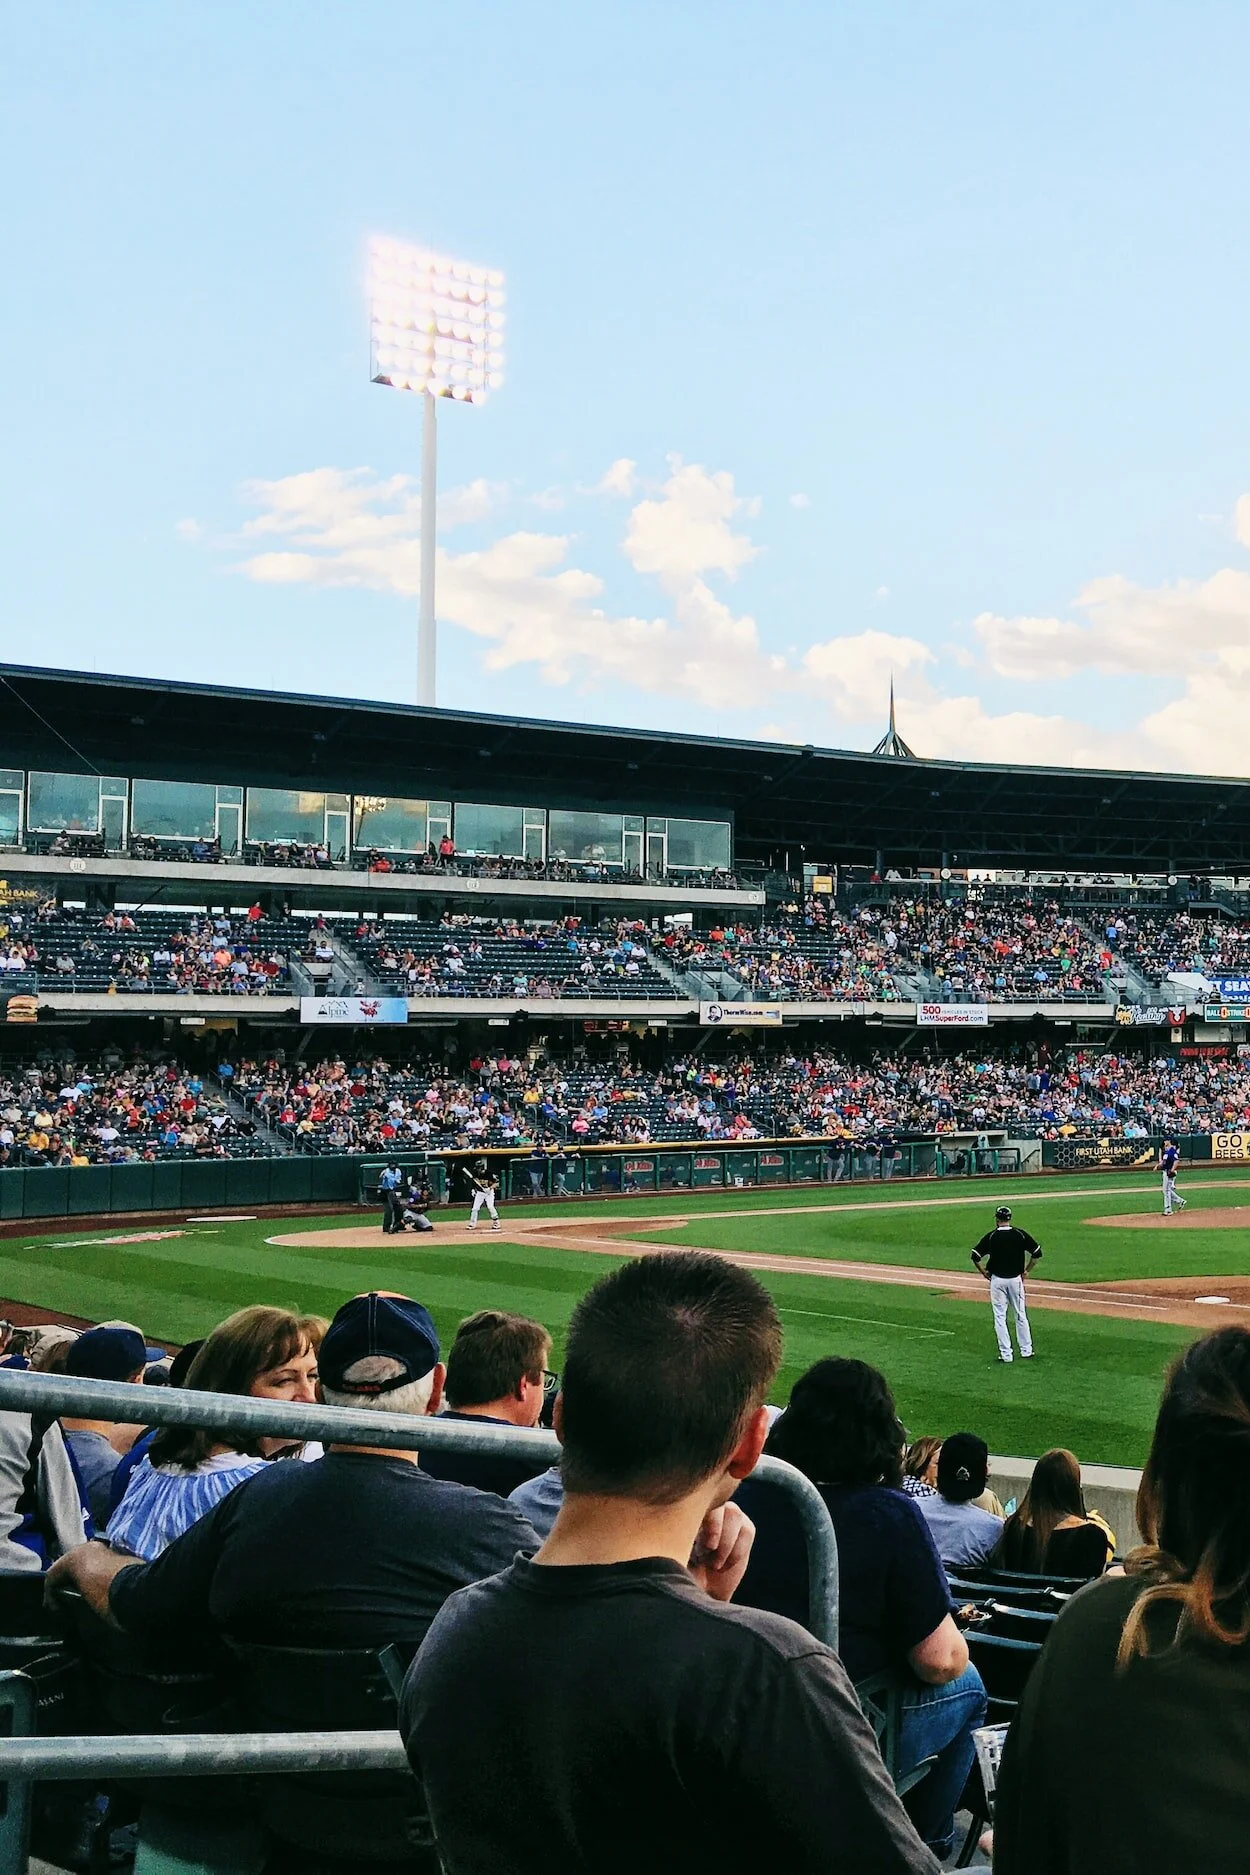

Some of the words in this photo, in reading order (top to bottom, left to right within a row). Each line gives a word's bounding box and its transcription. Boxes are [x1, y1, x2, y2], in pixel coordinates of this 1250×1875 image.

[13, 889, 38, 898] BANK
[922, 1005, 941, 1014] 500
[1221, 1006, 1227, 1018] 0
[1245, 1006, 1250, 1018] 0
[1217, 1135, 1242, 1148] GO
[1076, 1148, 1094, 1156] FIRST
[1094, 1147, 1113, 1155] UTAH
[1114, 1146, 1133, 1154] BANK
[1215, 1148, 1244, 1159] BEES
